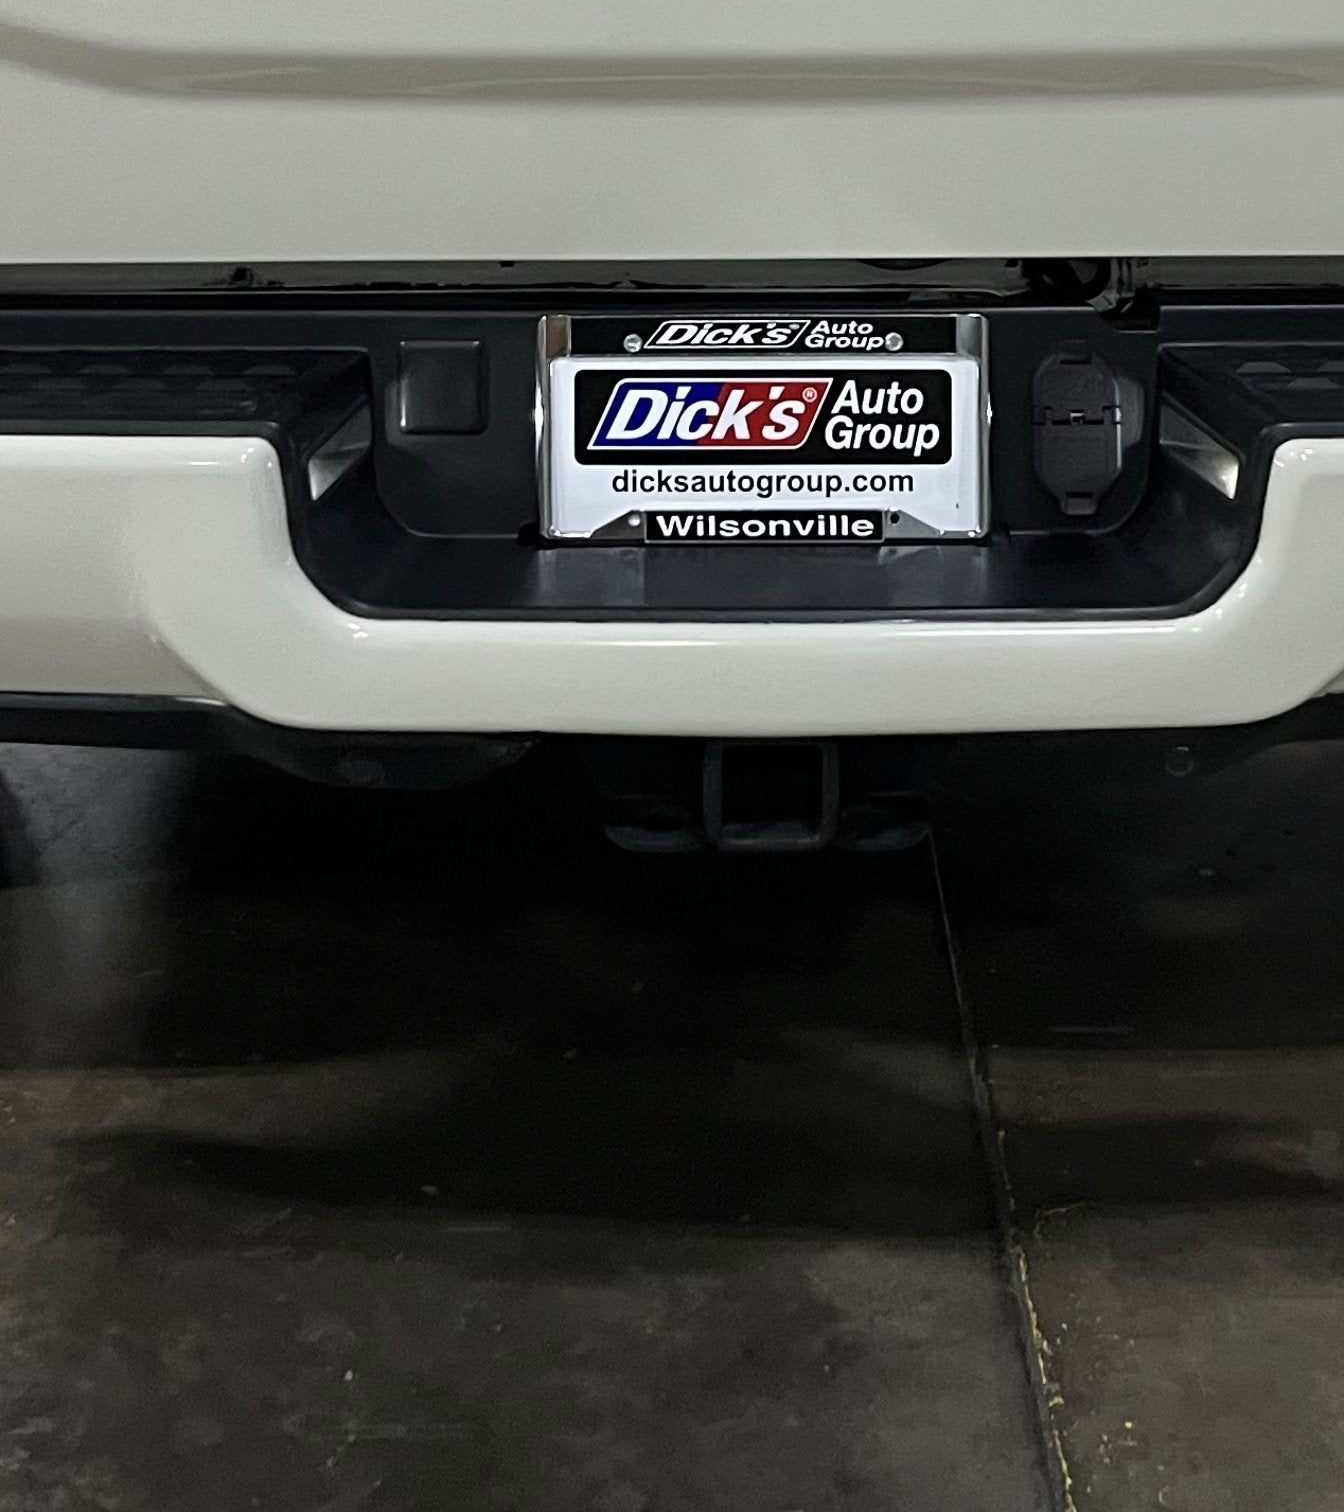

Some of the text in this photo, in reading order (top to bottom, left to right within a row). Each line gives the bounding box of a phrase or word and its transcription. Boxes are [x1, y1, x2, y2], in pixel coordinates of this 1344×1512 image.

[659, 322, 794, 346] Dick's
[810, 320, 874, 335] Auto
[804, 334, 886, 351] Group
[831, 380, 924, 415] Auto
[606, 386, 801, 440] Dick's
[824, 420, 940, 457] Group
[612, 470, 915, 499] dicksautogroup.com
[656, 515, 876, 537] Wilsonville
